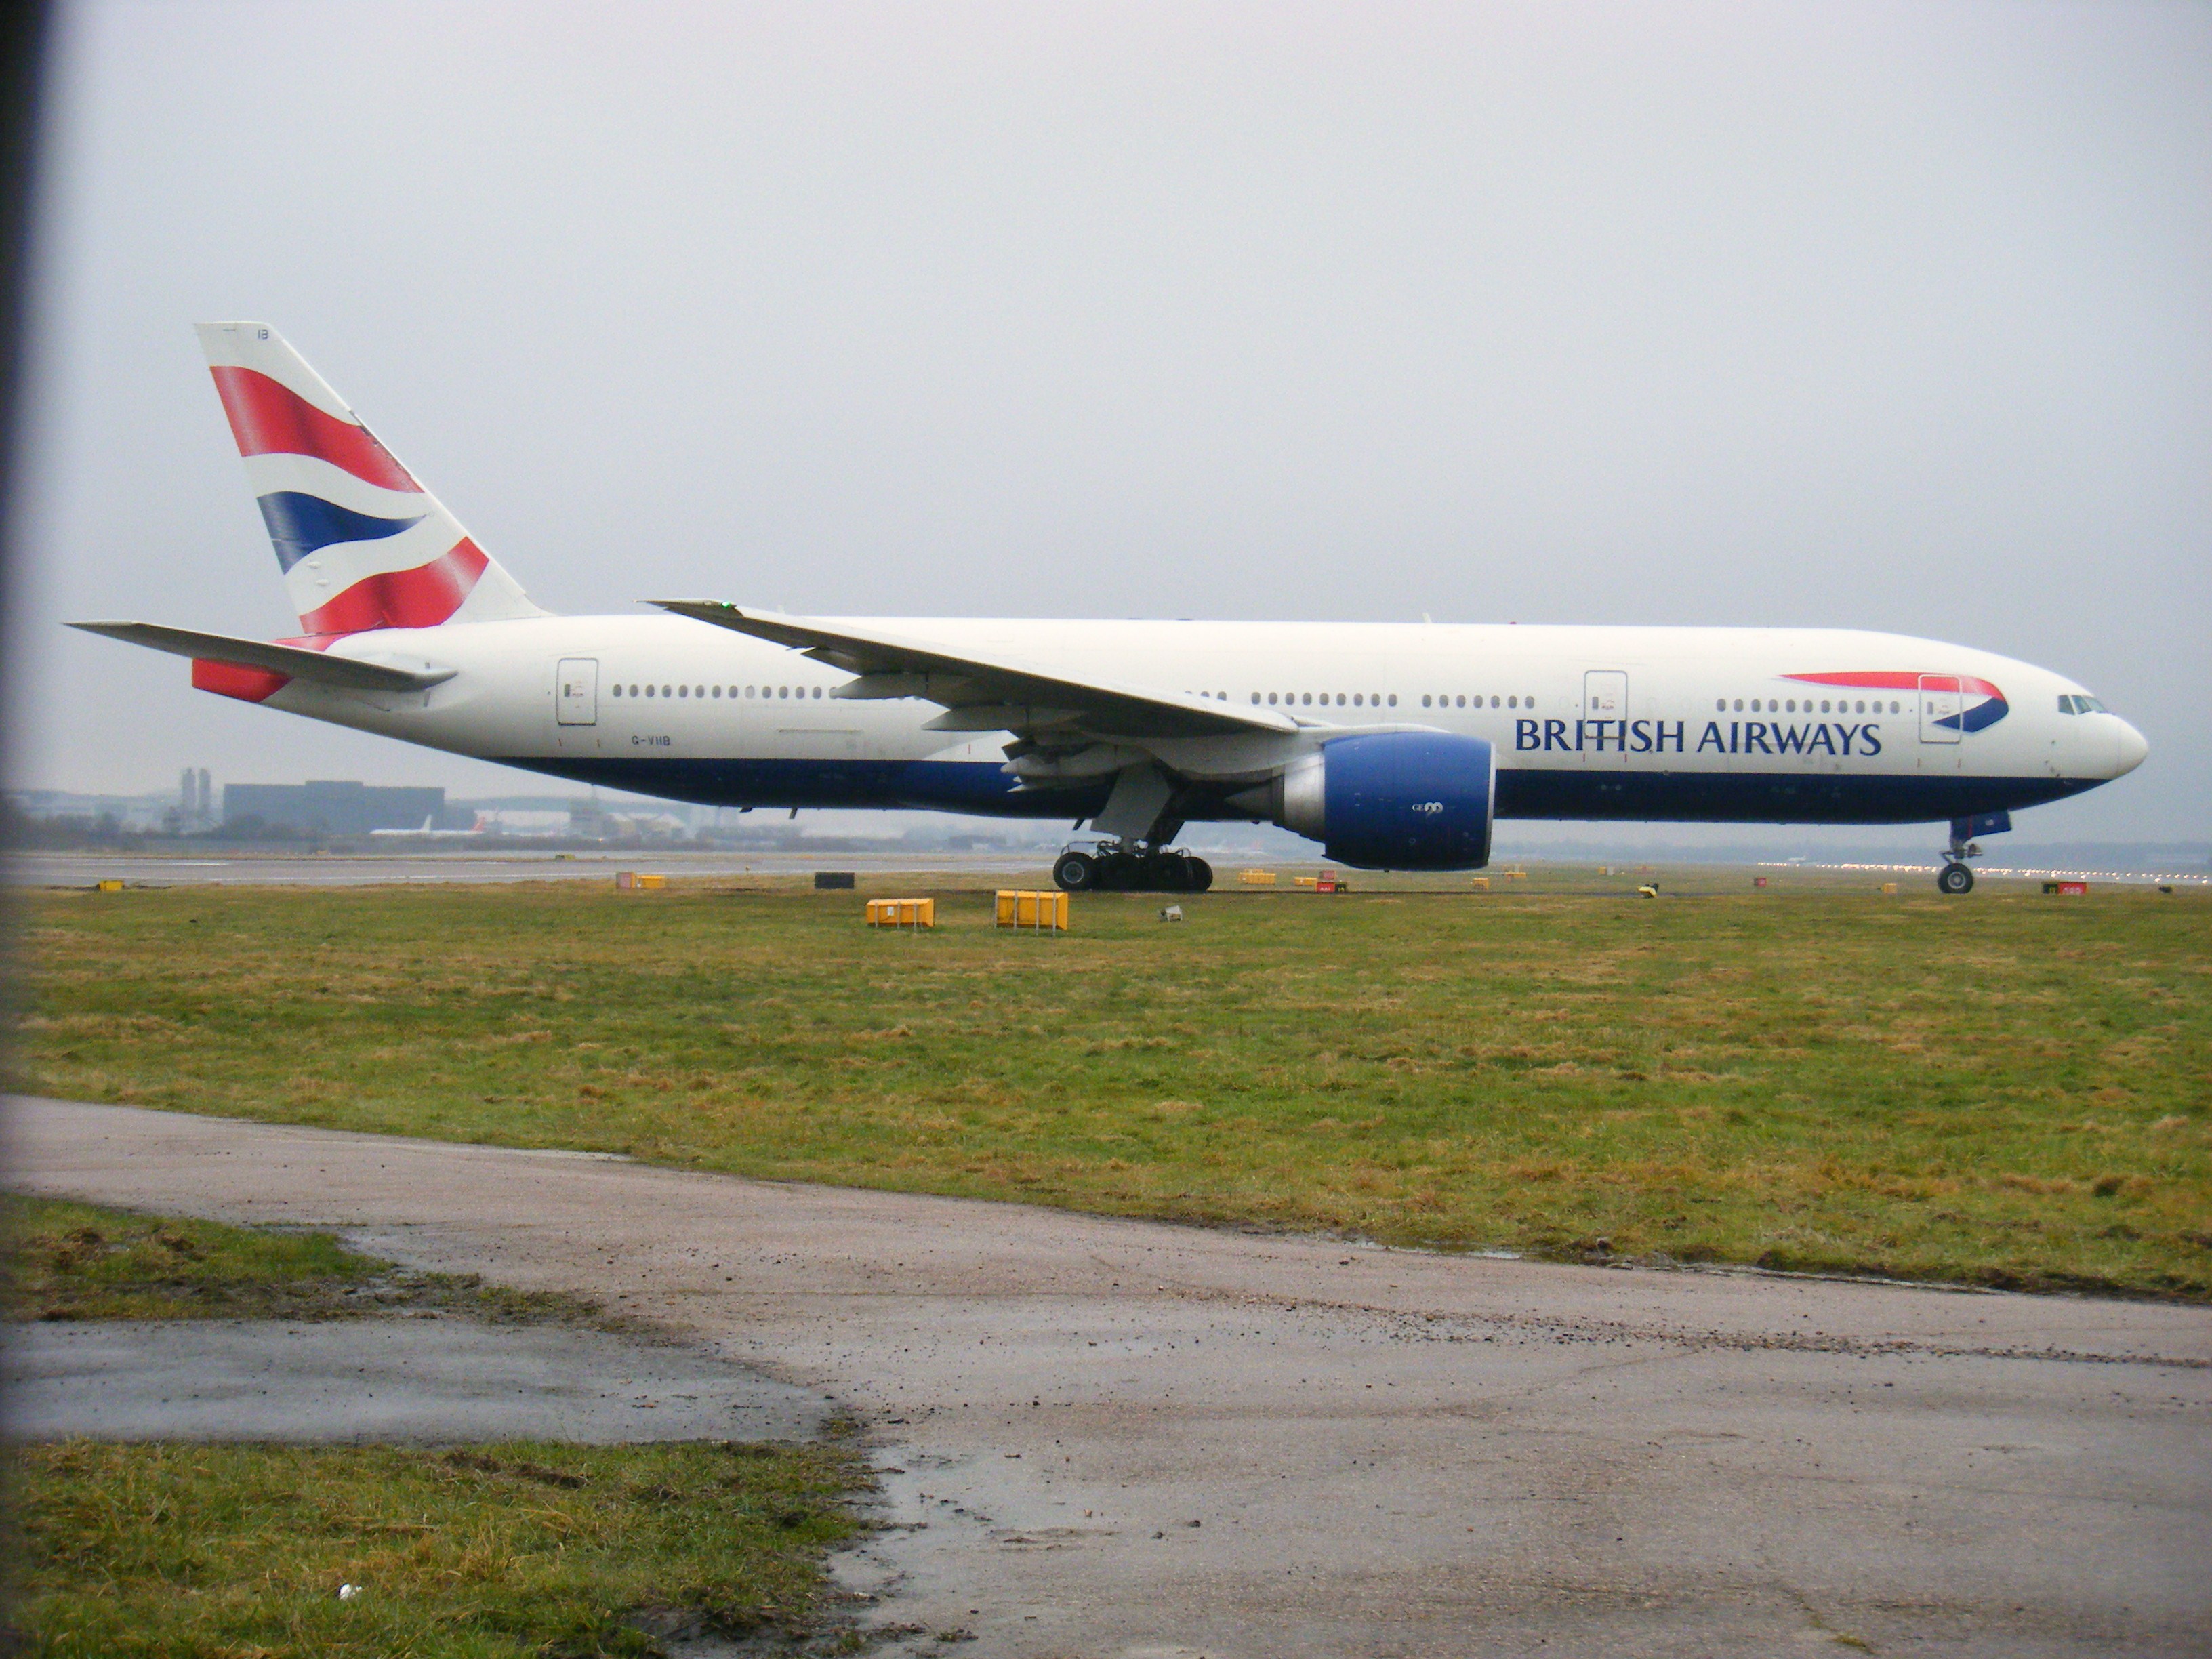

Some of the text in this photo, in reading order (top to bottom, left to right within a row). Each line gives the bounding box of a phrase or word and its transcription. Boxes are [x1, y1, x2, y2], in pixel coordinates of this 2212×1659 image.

[632, 735, 670, 746] G-VIIB
[1516, 718, 1882, 756] BRITISH AIRWAYS
